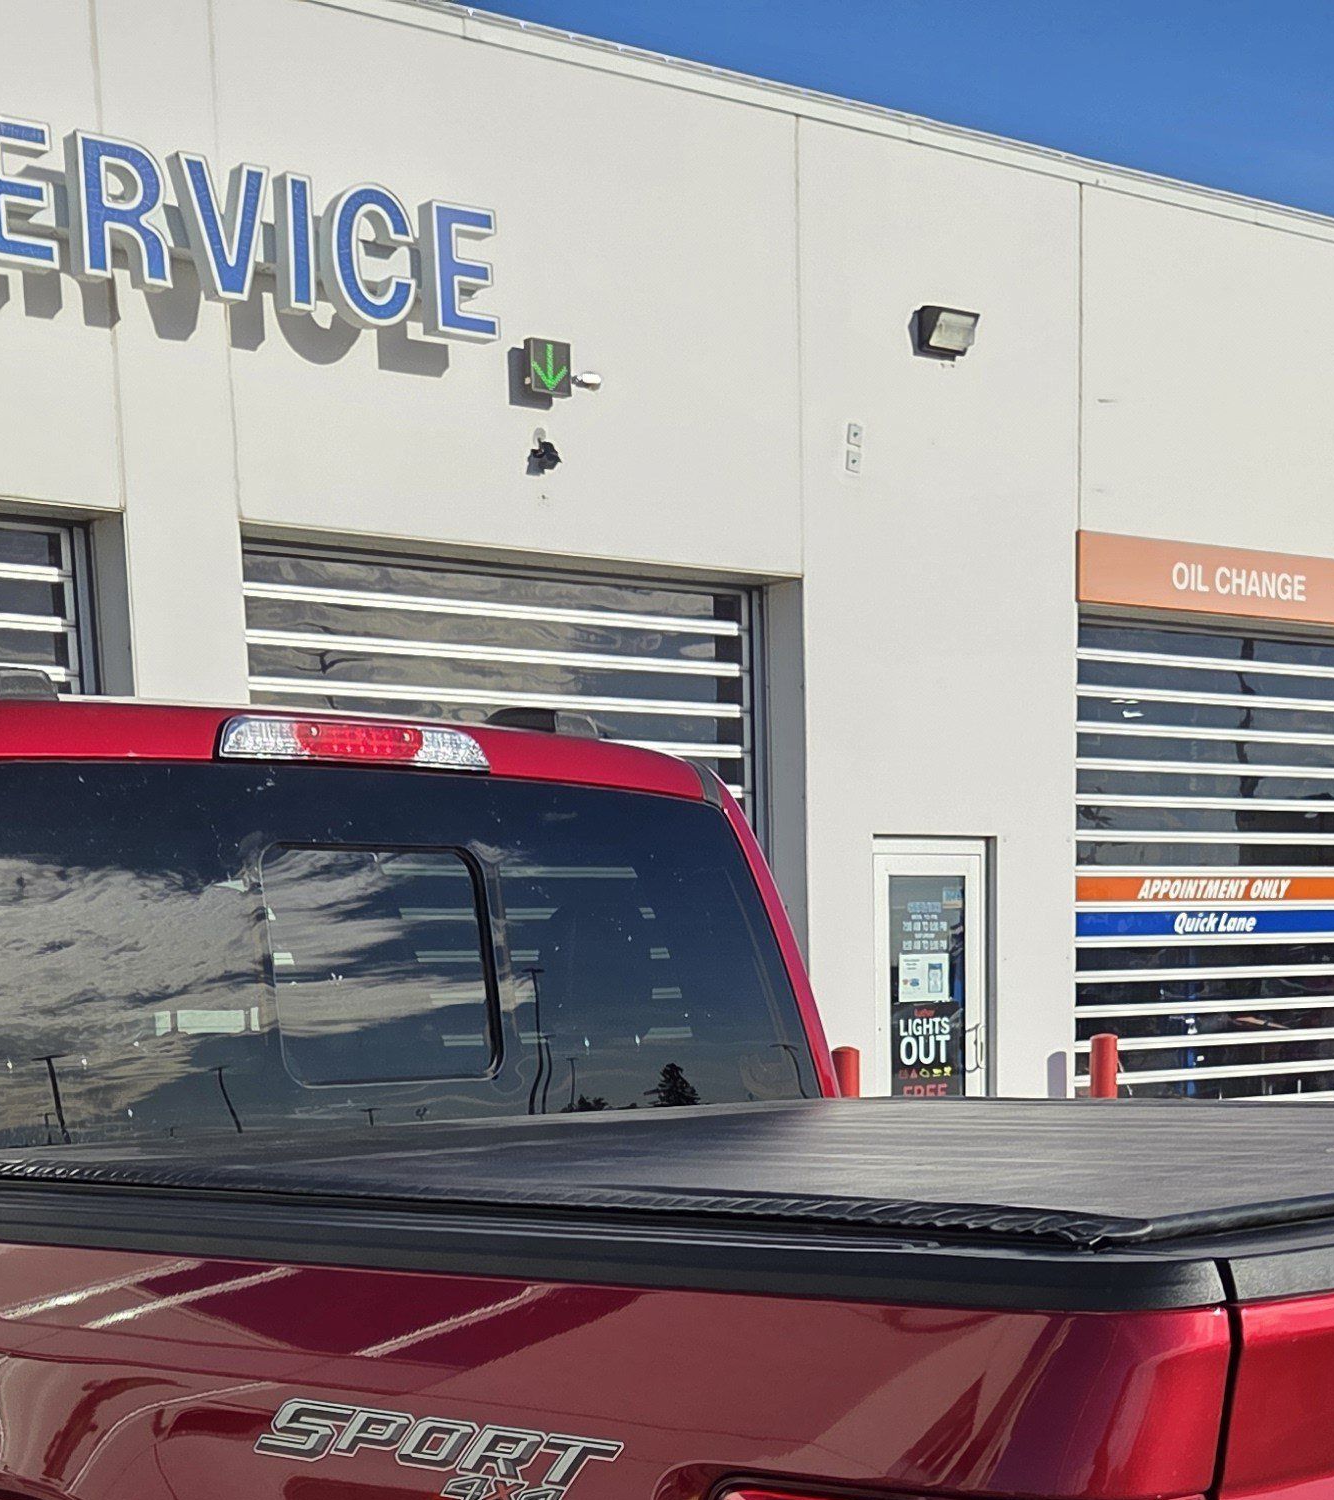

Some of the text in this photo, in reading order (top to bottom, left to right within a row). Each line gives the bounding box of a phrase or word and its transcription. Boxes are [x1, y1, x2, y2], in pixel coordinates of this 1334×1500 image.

[1171, 561, 1307, 602] OIL CHANGE
[1137, 878, 1291, 900] APPOINTMENT ONLY
[1173, 911, 1257, 935] Quick Lane
[899, 1016, 951, 1036] LIGHTS
[900, 1034, 951, 1066] OUT
[253, 1397, 625, 1489] SPORT
